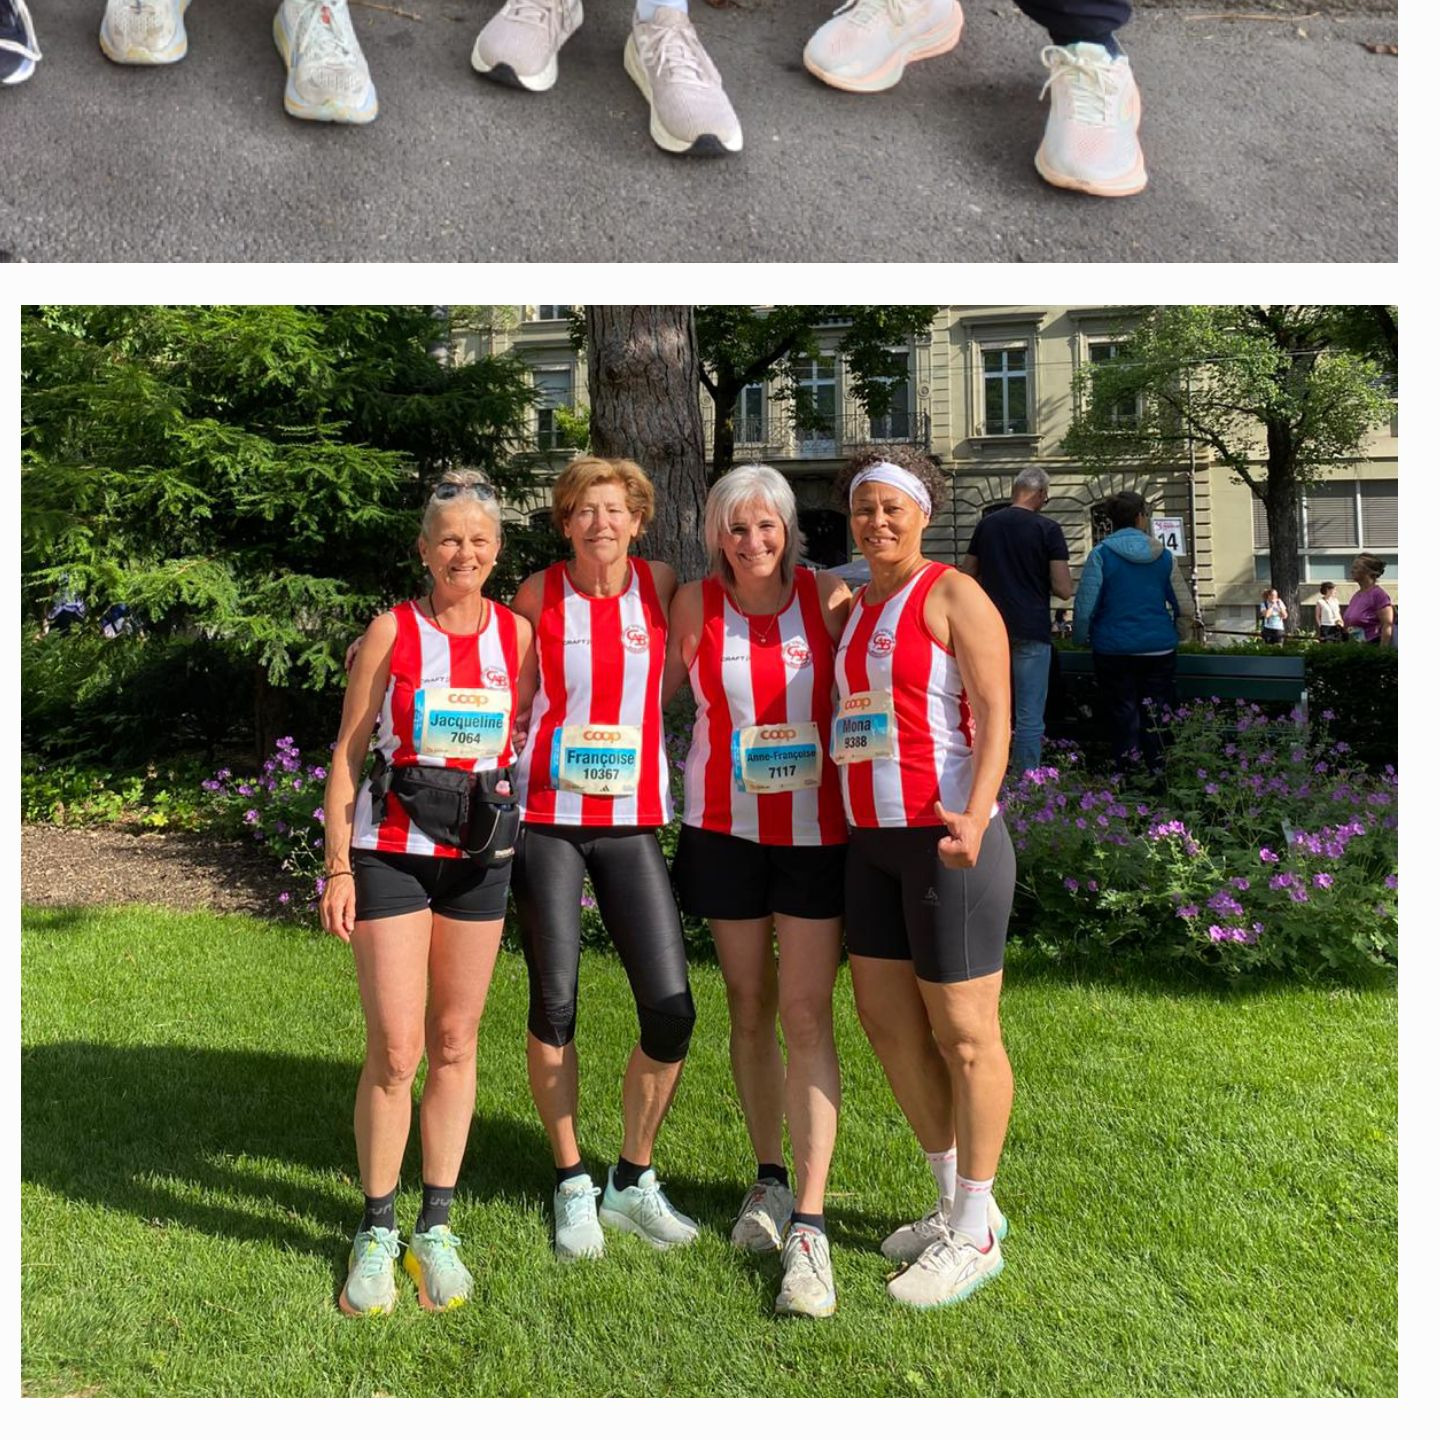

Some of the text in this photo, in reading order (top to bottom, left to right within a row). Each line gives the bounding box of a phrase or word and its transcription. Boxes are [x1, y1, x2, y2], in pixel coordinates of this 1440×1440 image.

[1158, 533, 1178, 550] 14
[448, 694, 488, 707] coop
[845, 697, 871, 710] coop
[430, 713, 504, 729] Jacqueline
[843, 720, 871, 733] Mona
[451, 732, 481, 744] 7064
[583, 730, 621, 743] coop
[760, 729, 796, 741] coop
[567, 749, 635, 767] Françoise
[747, 751, 817, 762] Anne-Françoise
[584, 768, 620, 780] 10367
[768, 765, 797, 779] 7117
